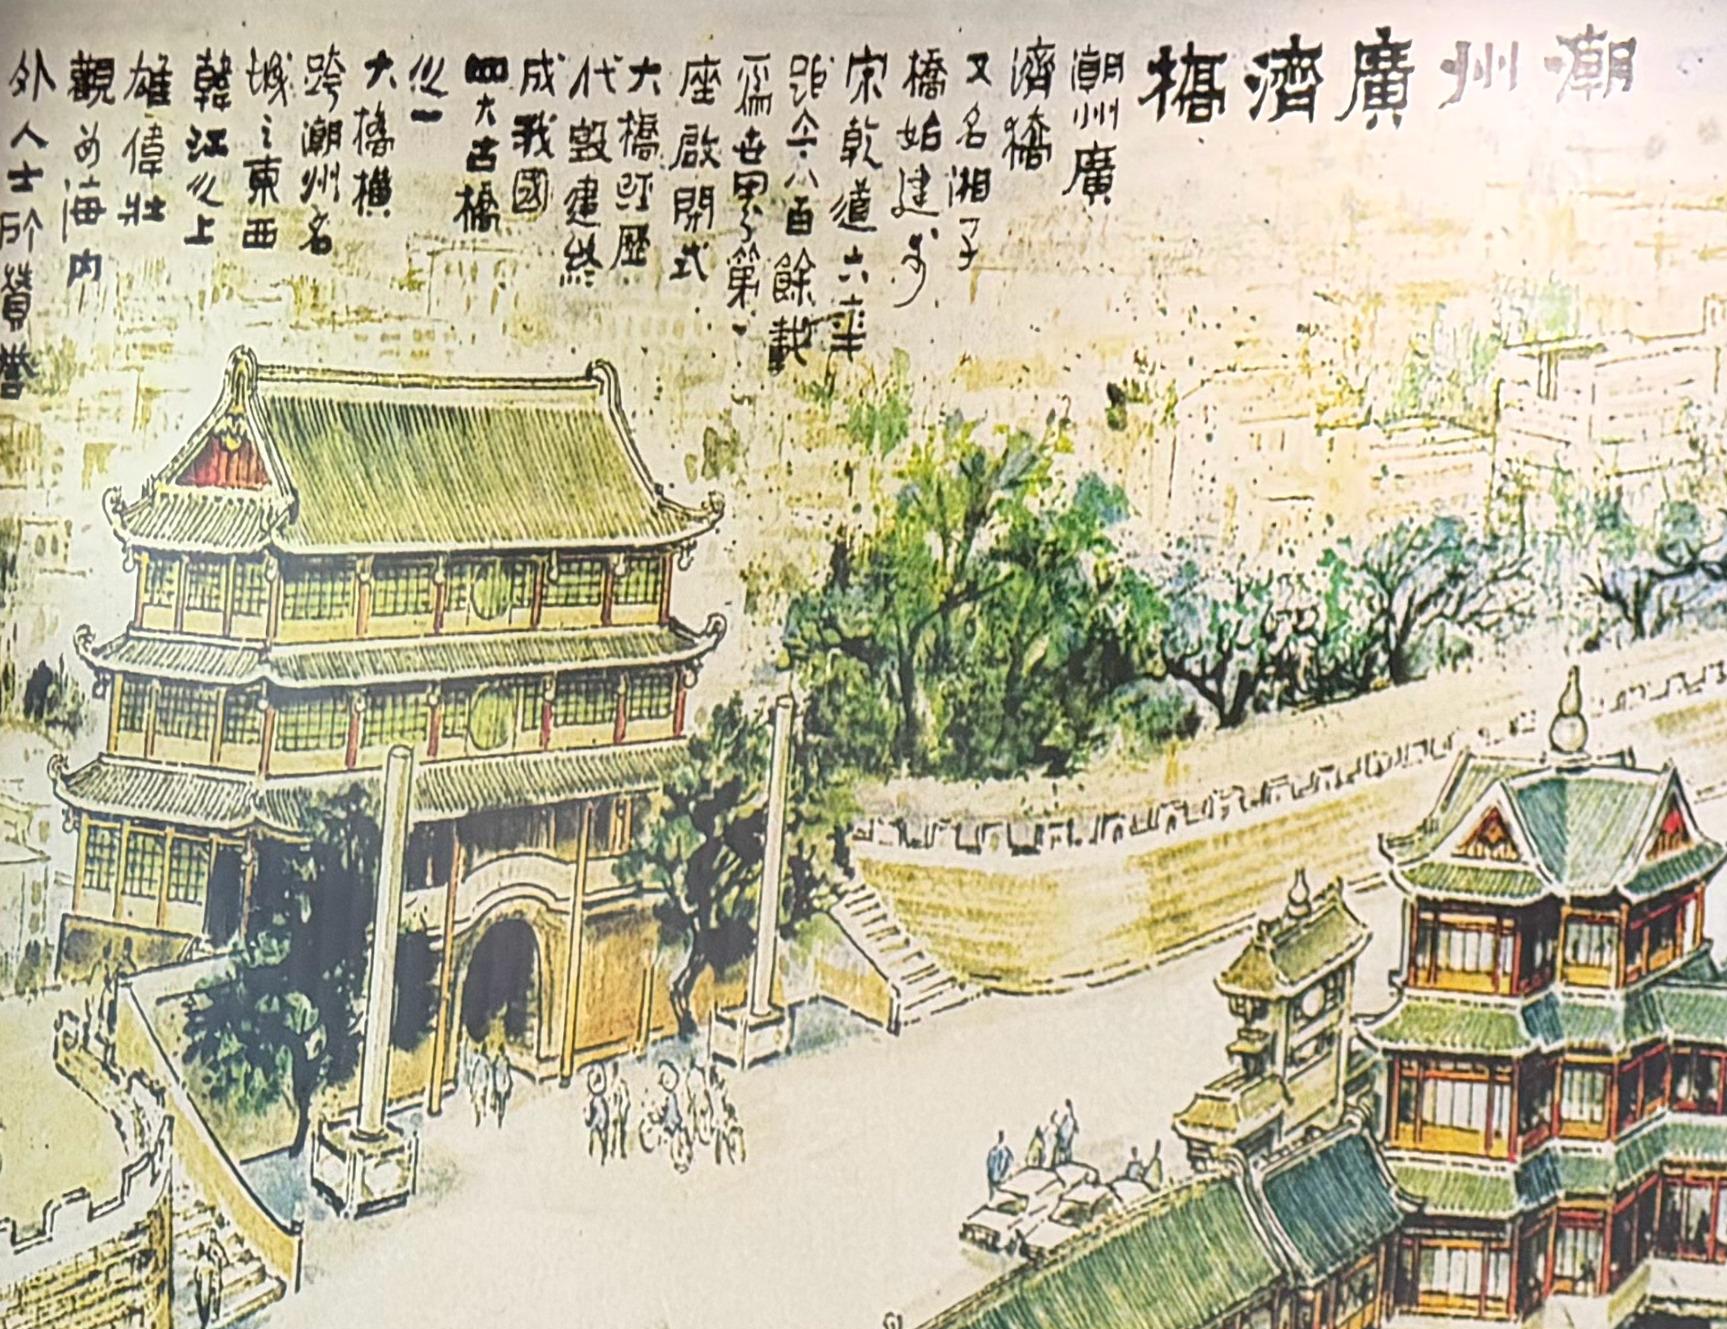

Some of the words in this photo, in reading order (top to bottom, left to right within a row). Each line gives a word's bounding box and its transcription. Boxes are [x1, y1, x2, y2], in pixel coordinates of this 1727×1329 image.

[117, 49, 173, 226] 雄偉壯
[183, 47, 232, 245] 韓江之上
[242, 46, 296, 249] 城之東西
[298, 42, 346, 255] 跨潮州名
[351, 48, 397, 217] 大橋橫
[408, 53, 449, 123] 之一
[453, 52, 509, 232] 四大古橋
[511, 48, 566, 214] 成我國
[944, 52, 992, 271] 又名湘子
[1002, 35, 1056, 171] 濟橋
[1062, 43, 1124, 206] 潮州廣
